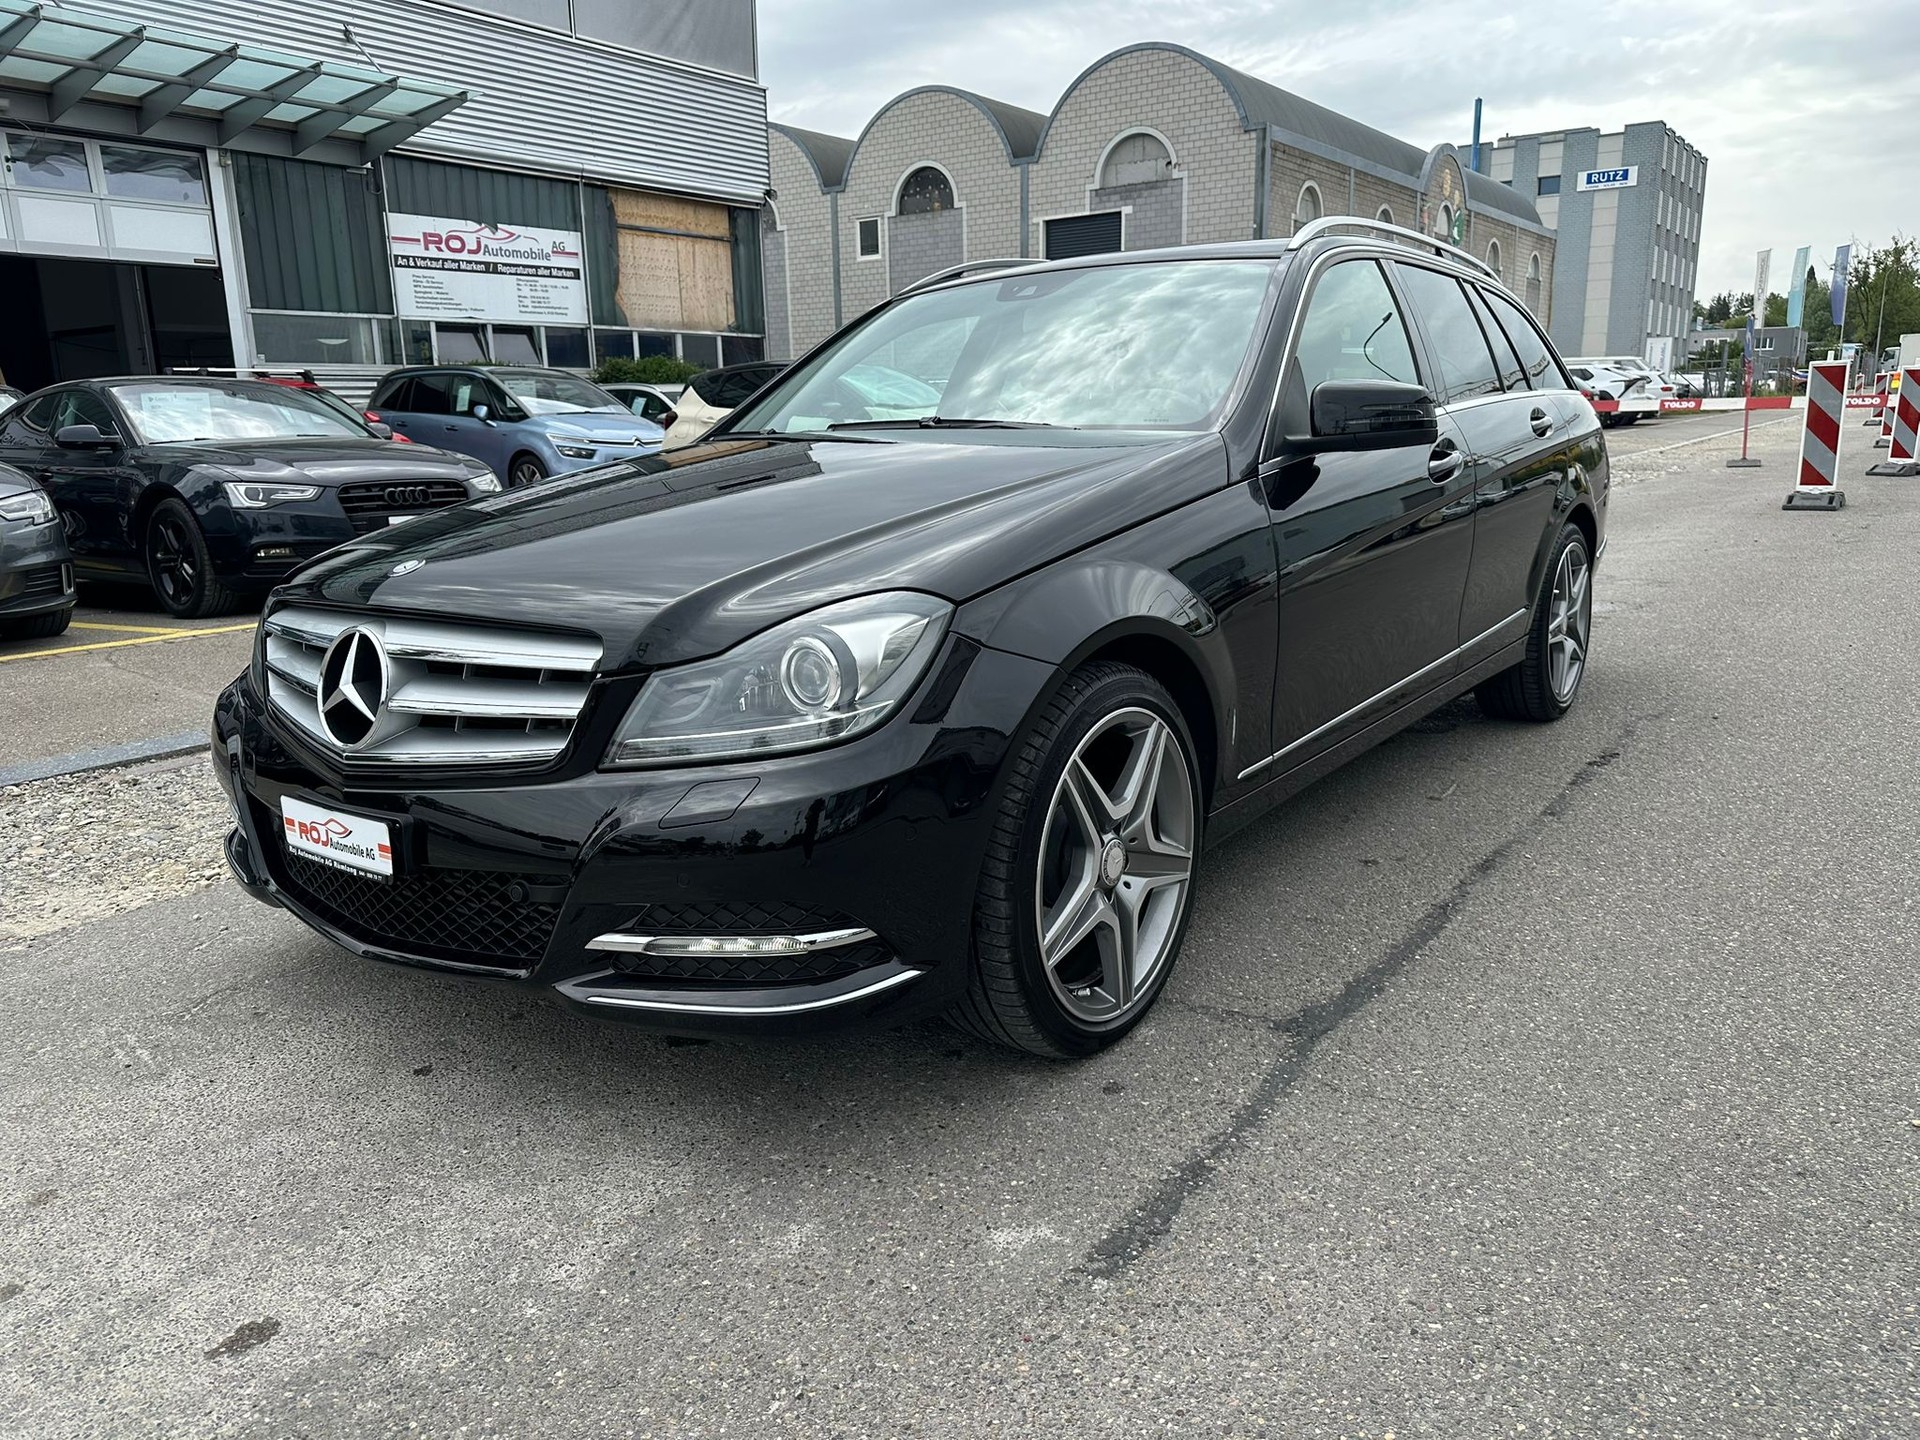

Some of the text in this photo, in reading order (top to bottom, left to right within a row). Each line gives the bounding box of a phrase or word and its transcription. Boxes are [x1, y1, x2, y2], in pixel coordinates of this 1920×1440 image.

[1591, 170, 1624, 182] RUTZ
[482, 244, 551, 261] Automobile
[552, 240, 565, 252] AG
[397, 256, 407, 266] An
[409, 258, 415, 266] &
[415, 258, 442, 269] Verkauf
[443, 260, 458, 270] aller
[460, 261, 486, 271] Marken
[497, 264, 536, 276] Reparaturen
[537, 266, 550, 276] aller
[551, 268, 574, 278] Marken
[1846, 397, 1881, 405] TOLDO
[298, 820, 376, 861] ROJ Automobile AG
[298, 847, 324, 864] Automobile
[325, 858, 333, 866] AG
